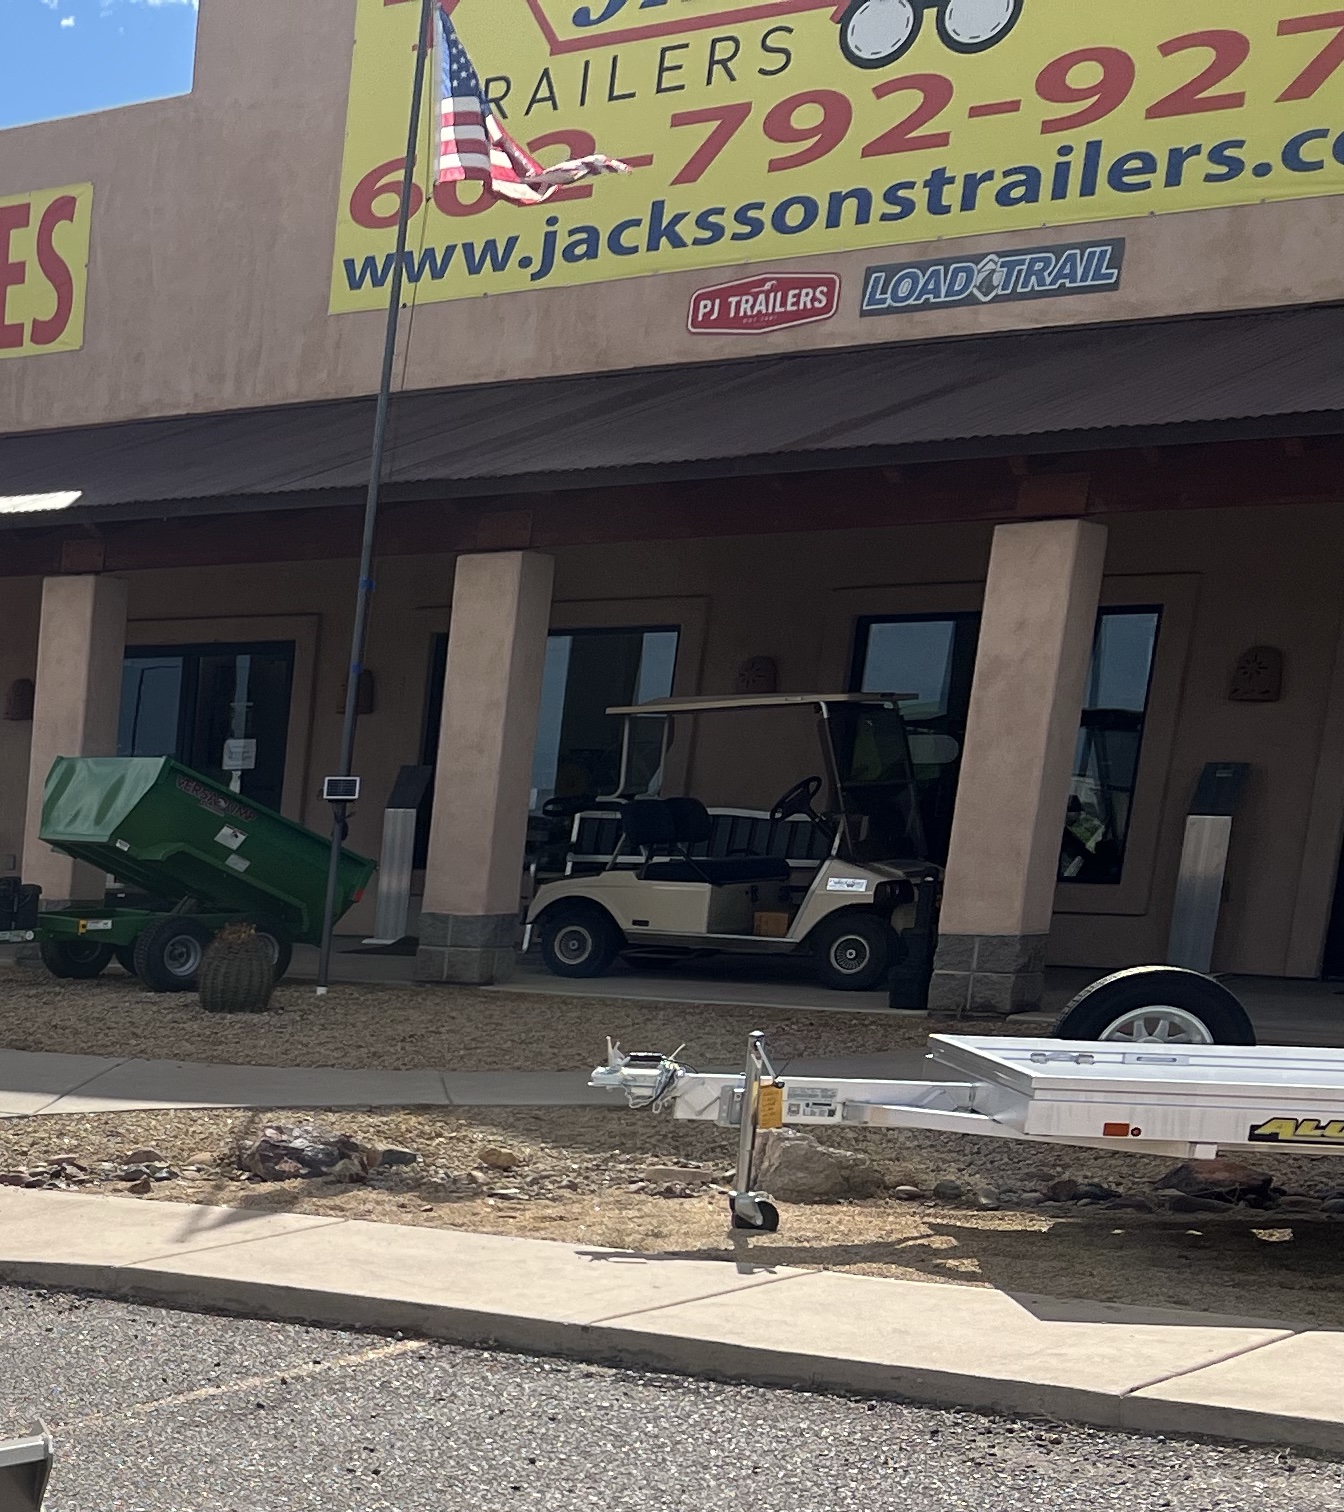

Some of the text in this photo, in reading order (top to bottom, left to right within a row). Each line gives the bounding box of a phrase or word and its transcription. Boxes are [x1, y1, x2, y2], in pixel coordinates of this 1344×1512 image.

[482, 25, 795, 120] RAILERS
[343, 129, 1344, 291] www.jackssonstrailers.c
[697, 286, 828, 322] PJ TRAILERS
[863, 245, 1119, 310] LOAD TRAIL
